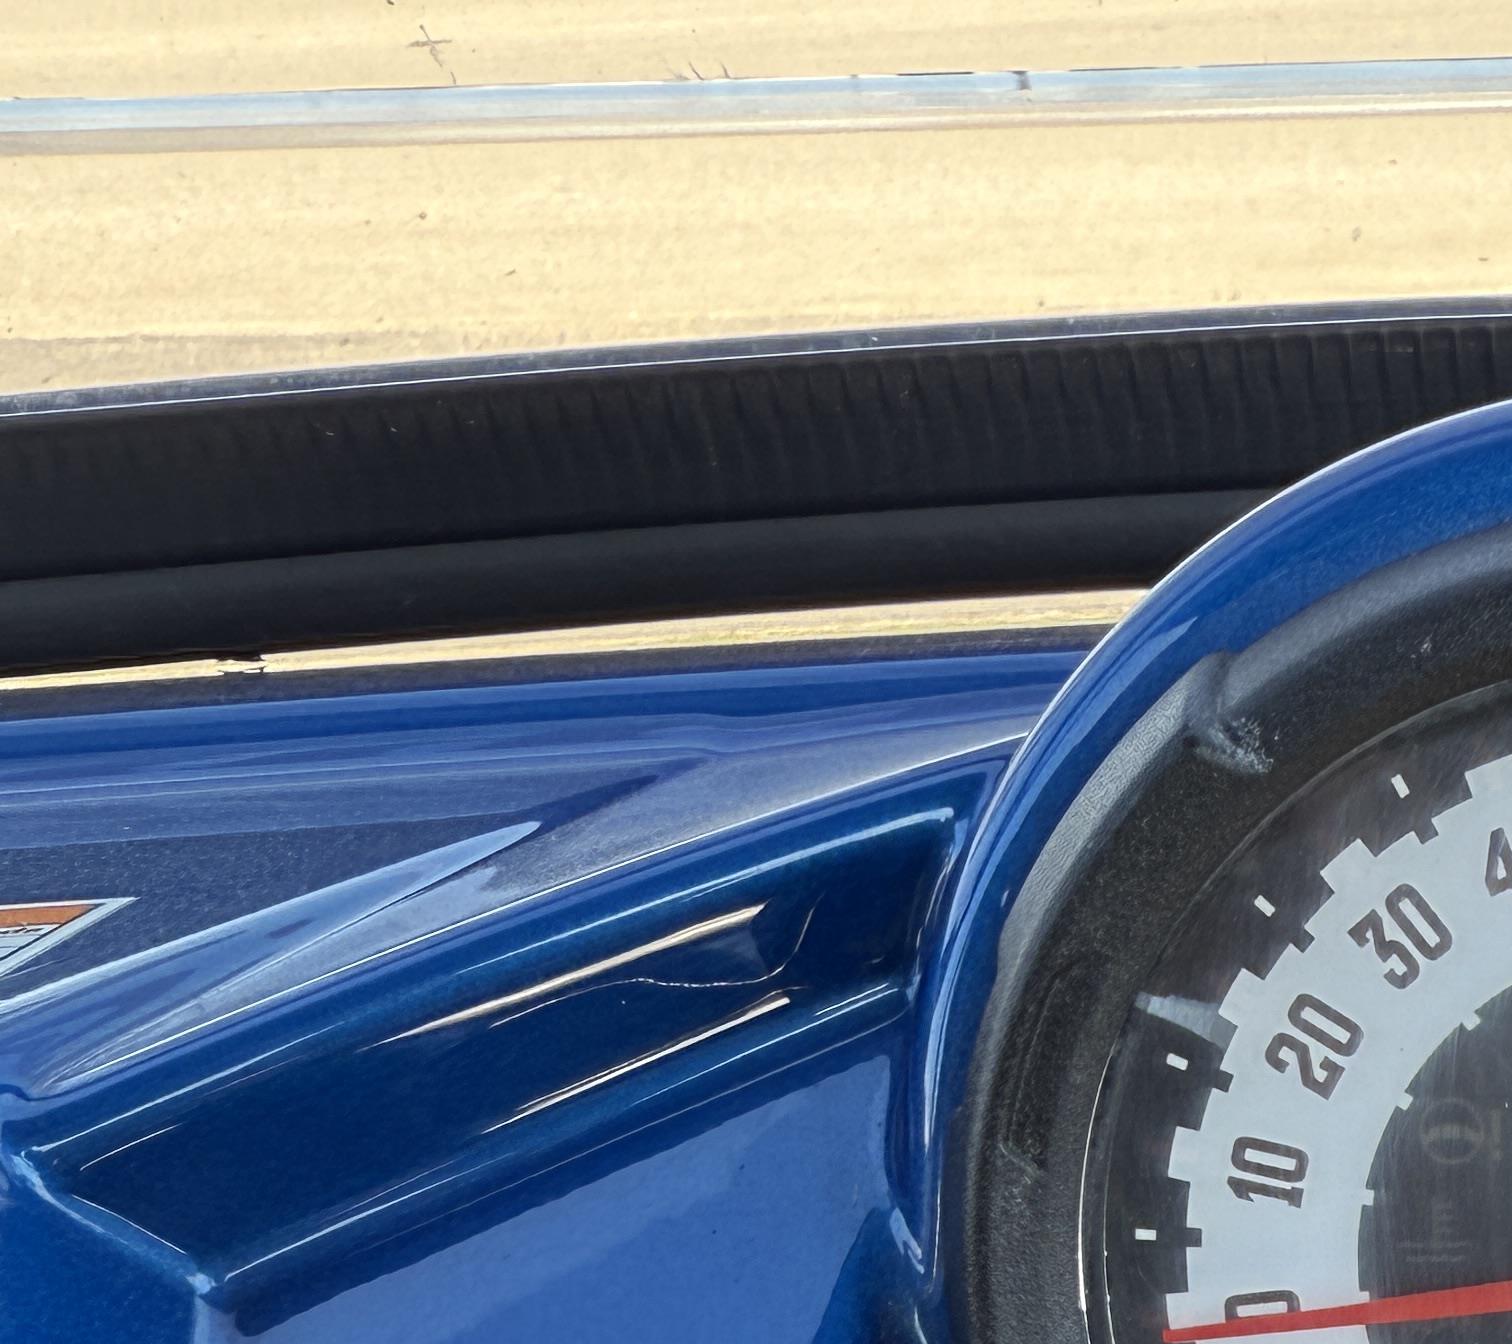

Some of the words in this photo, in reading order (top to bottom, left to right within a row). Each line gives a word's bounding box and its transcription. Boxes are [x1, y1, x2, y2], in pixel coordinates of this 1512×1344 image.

[1348, 883, 1453, 989] 30
[1265, 993, 1364, 1100] 20
[1227, 1136, 1309, 1208] 10
[1225, 1290, 1301, 1322] 0
